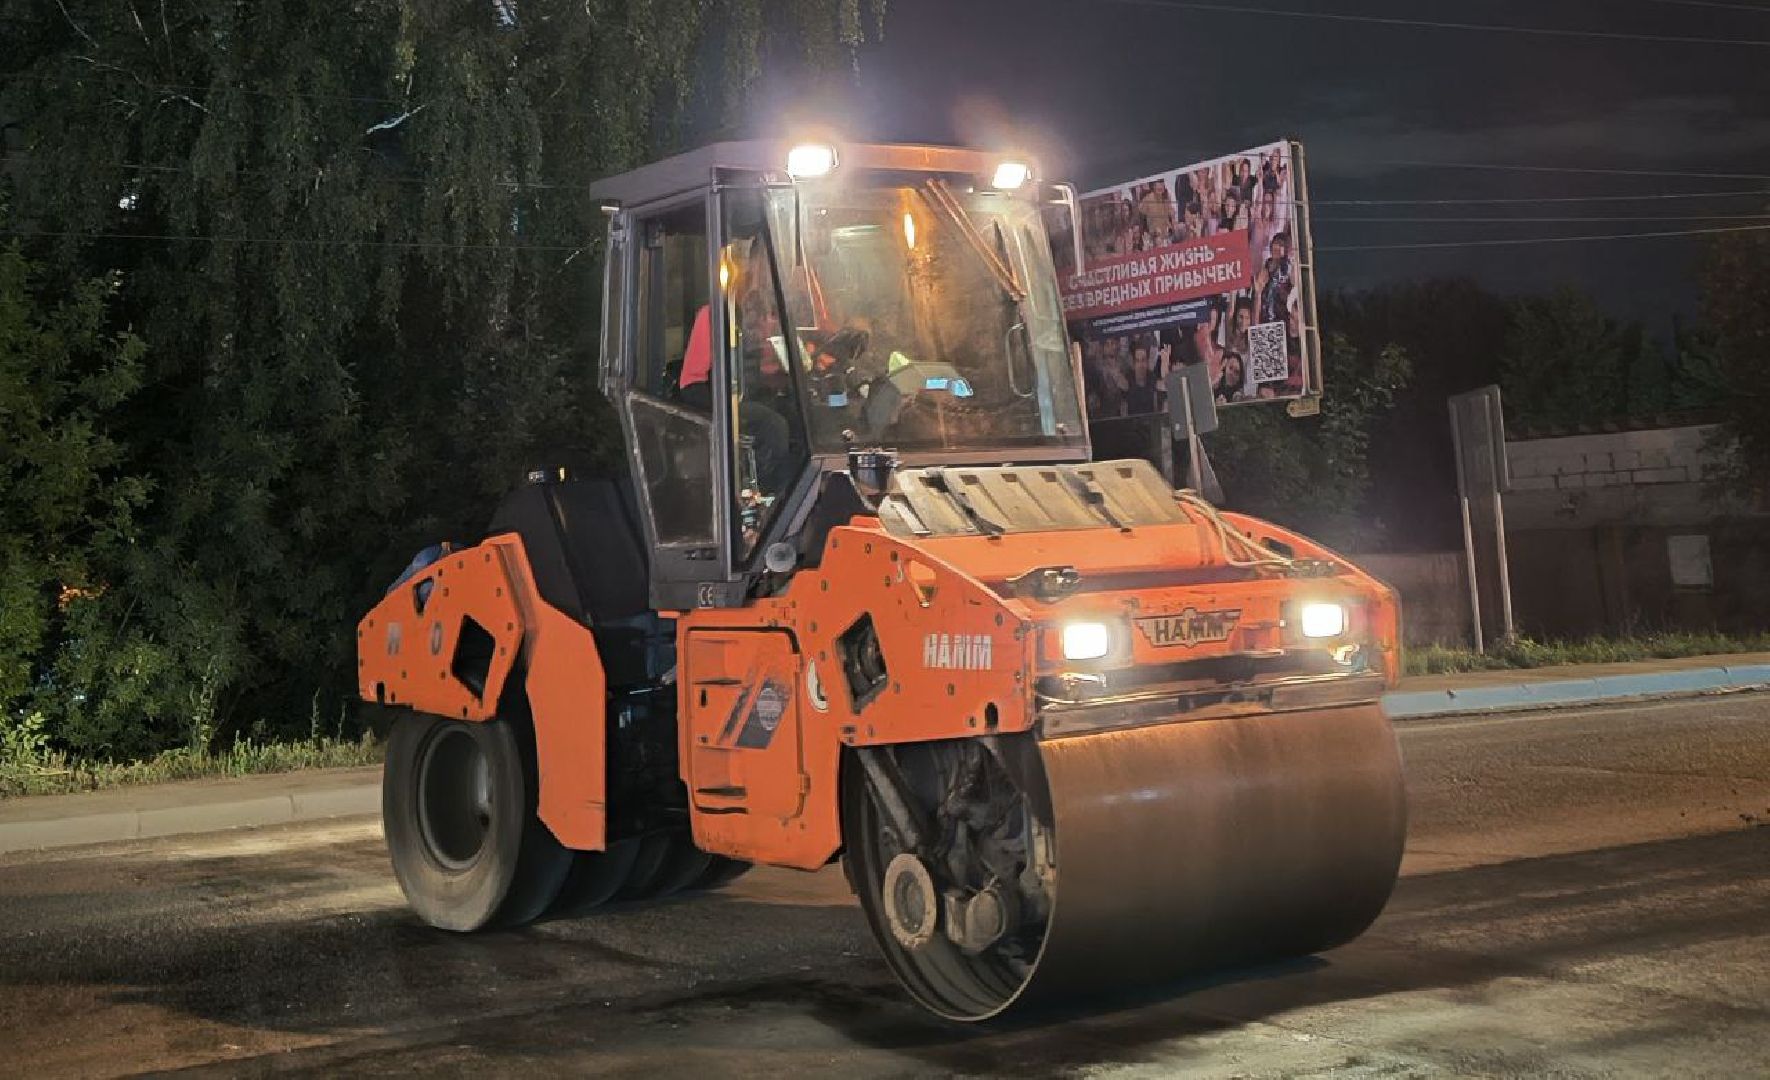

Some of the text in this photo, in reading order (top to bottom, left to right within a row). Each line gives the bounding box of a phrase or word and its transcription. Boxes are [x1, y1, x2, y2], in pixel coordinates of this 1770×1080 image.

[1160, 246, 1215, 272] ЖИЗНЬ
[1087, 278, 1151, 307] ВРЕДНЫХ
[1156, 261, 1241, 294] ПРИВЫЧЕК!
[1154, 611, 1225, 643] HAMM
[924, 633, 992, 670] HAMM
